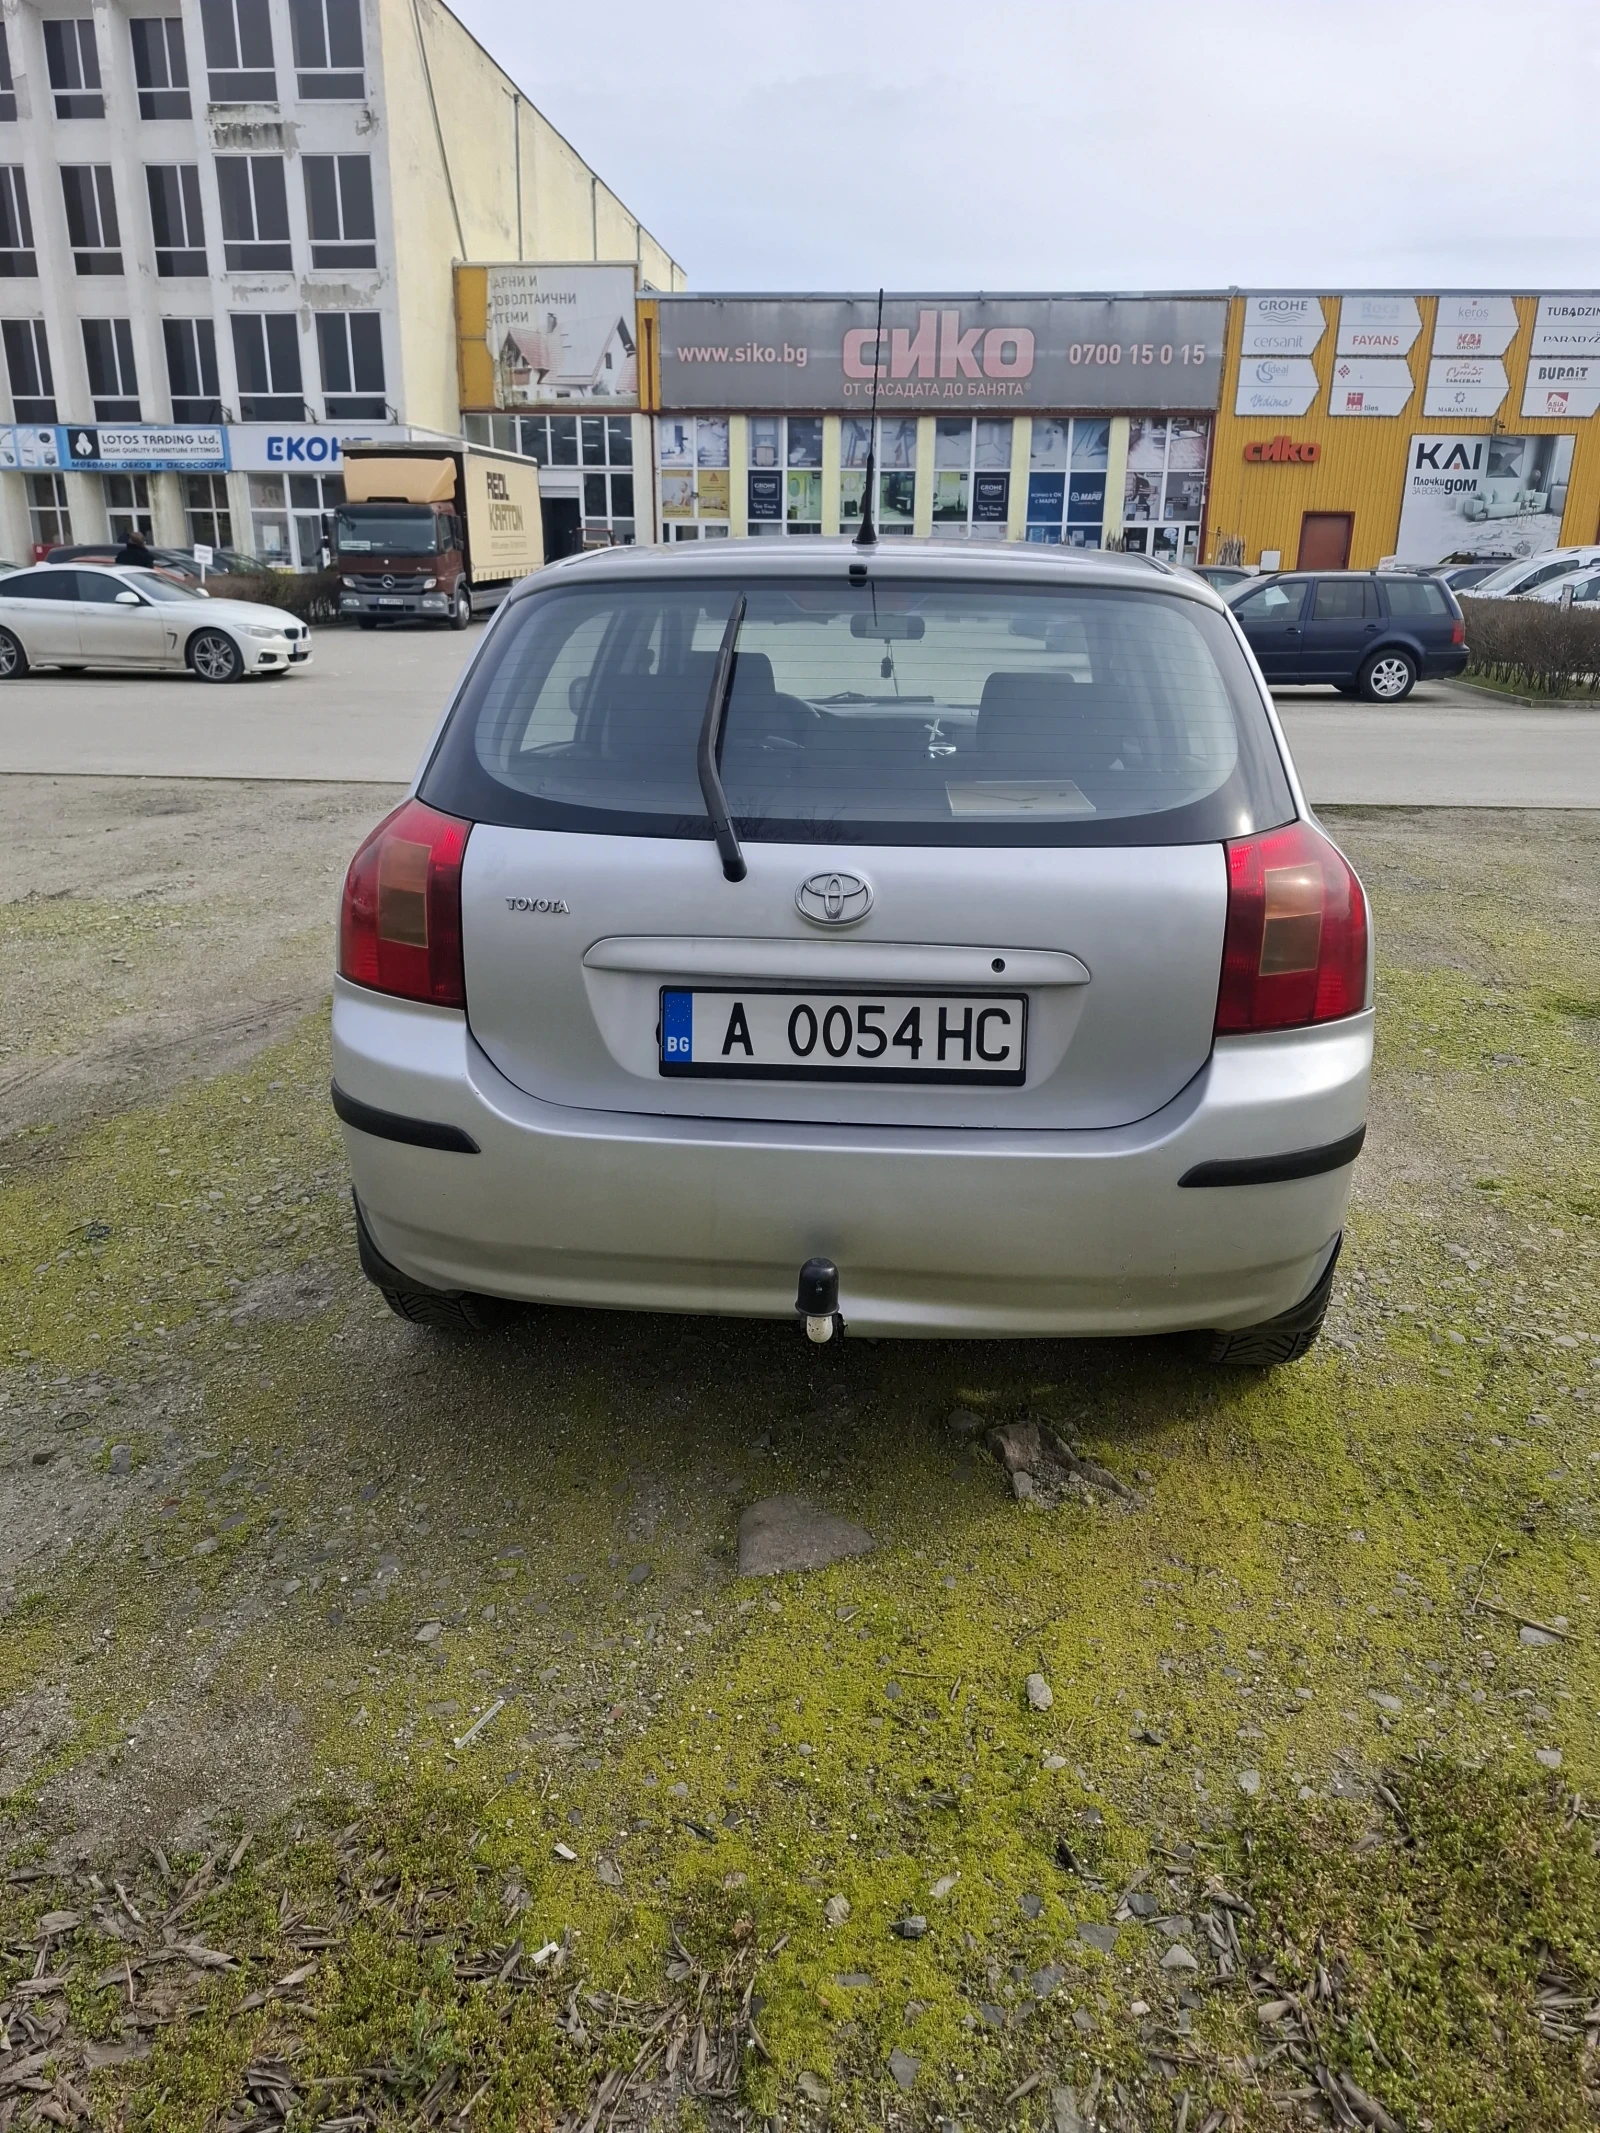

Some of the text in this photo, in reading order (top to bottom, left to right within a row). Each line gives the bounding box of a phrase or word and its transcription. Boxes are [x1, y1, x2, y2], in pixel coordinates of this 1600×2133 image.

[529, 275, 537, 287] И
[1258, 300, 1308, 311] GROHE
[1458, 307, 1489, 318] keros
[1253, 336, 1303, 347] cersanit
[1352, 335, 1399, 346] FAYANS
[677, 343, 808, 367] www.siko.bg
[1069, 344, 1205, 365] 0700 15 0 15
[843, 383, 861, 396] ОТ
[865, 383, 940, 398] ФАСАДАТА
[943, 383, 963, 398] ДО
[102, 435, 219, 445] LOTOS TRADING Ltd.
[267, 436, 372, 462] ЕКОН
[1415, 443, 1483, 470] KAI
[505, 896, 570, 914] TOYOTA
[721, 1002, 754, 1056] A
[667, 1037, 690, 1053] BG
